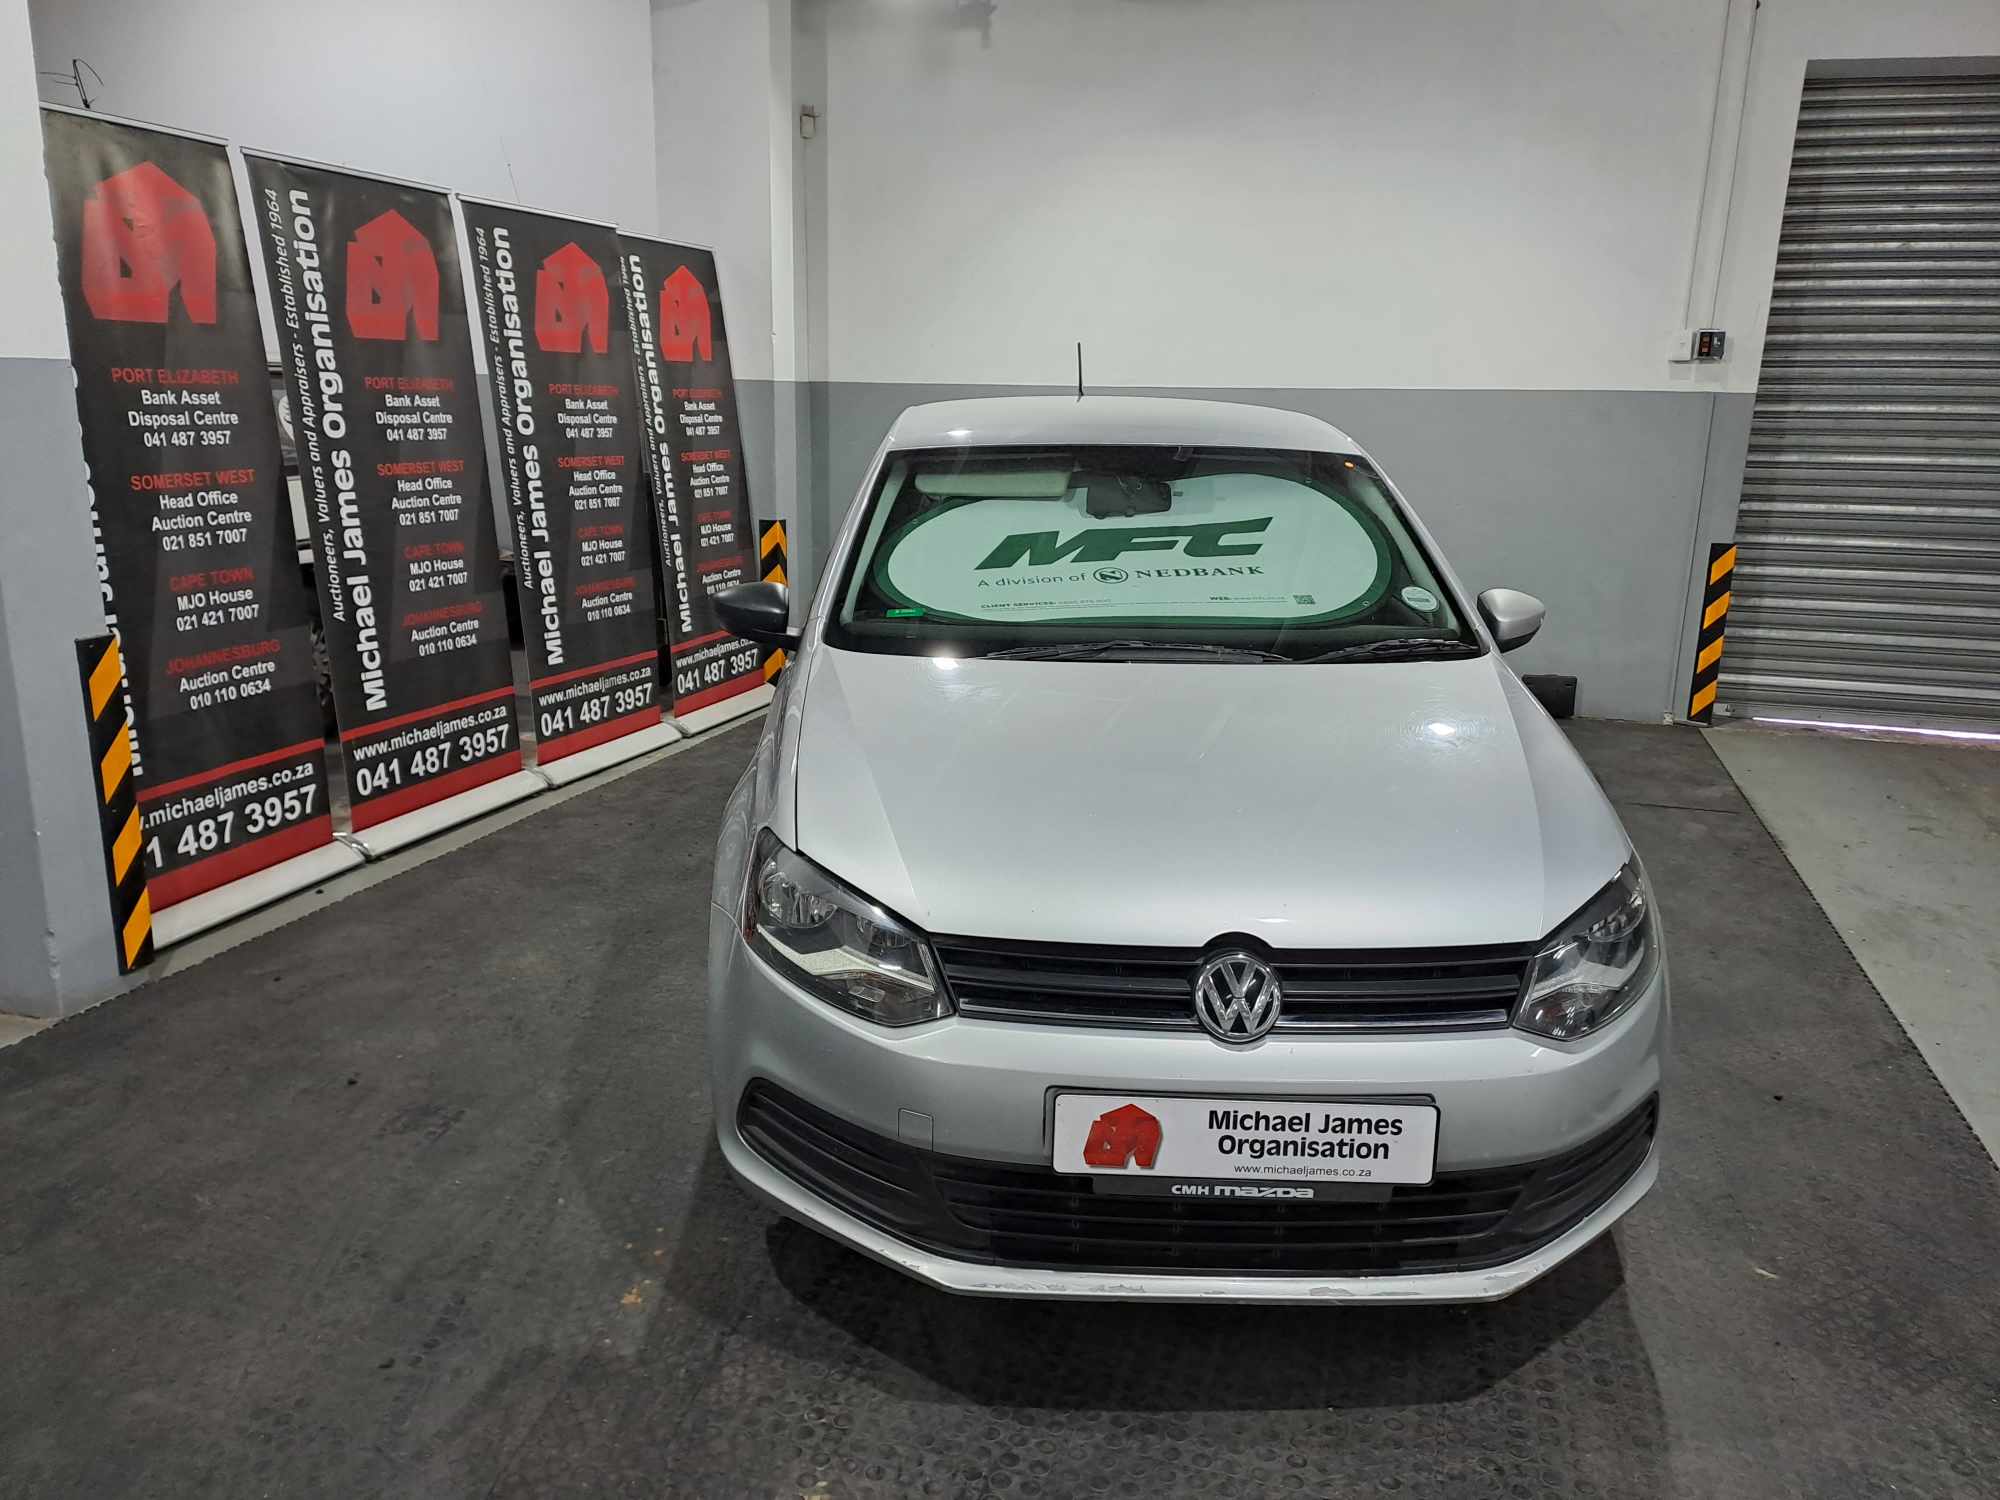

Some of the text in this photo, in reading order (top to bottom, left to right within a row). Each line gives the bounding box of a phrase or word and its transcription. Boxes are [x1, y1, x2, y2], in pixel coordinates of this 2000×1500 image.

[111, 367, 240, 385] PORT ELIZABETH
[140, 389, 222, 405] Bank Asset
[264, 187, 346, 622] Auctioneers, Valuers and Appraisers Established 1964
[385, 395, 441, 408] Bank Asset
[475, 227, 534, 589] Auctioneers, Valuers and Appraisers Established 1964
[128, 410, 239, 429] Disposal Centre
[376, 411, 453, 426] Disposal Centre
[557, 413, 617, 425] Disposal Centre
[143, 430, 232, 447] 041 487 3957
[386, 427, 448, 442] 041 487 3957
[628, 254, 693, 633] Michael James Organisation
[289, 189, 388, 712] Michael James Organisation
[493, 227, 564, 666] Michael James Organisation
[130, 468, 256, 491] SOMERSET WEST
[398, 477, 453, 492] Head Office
[593, 469, 616, 480] Office
[159, 491, 239, 510] Head Office
[568, 483, 623, 497] Auction Centre
[392, 493, 462, 511] Auction Centre
[151, 510, 252, 532] Auction Centre
[399, 509, 460, 527] 021 851 7007
[162, 528, 248, 551] 021 851 7007
[598, 539, 623, 550] House
[974, 516, 1273, 570] MFC
[409, 558, 464, 575] MJO House
[977, 565, 1265, 587] A division of NEDBANK
[170, 567, 254, 590] CAPE TOWN
[409, 571, 468, 592] 021 421 7007
[176, 588, 254, 612] MJO House
[581, 591, 633, 608] Auction Centre
[176, 604, 260, 632] 021 421 7007
[411, 618, 479, 643] Auction Centre
[419, 634, 477, 656] 010 110 0634
[179, 660, 276, 693] Auction Centre
[677, 648, 758, 695] 041 487 3957
[190, 678, 272, 711] 010 110 0634
[538, 666, 651, 707] www.michaeljames.co.za
[540, 682, 653, 737] 041 487 3957
[353, 704, 507, 761] www.michaeljames.co.za
[356, 723, 510, 796] 041 487 3957
[140, 762, 314, 830] .michaeljames.co.za
[176, 811, 235, 857] 487
[244, 783, 318, 834] 3957
[1208, 1110, 1403, 1136] Michael James
[1217, 1135, 1390, 1160] Organisation
[1233, 1163, 1372, 1178] www.michaeljames.co.za
[1171, 1184, 1210, 1196] CMH
